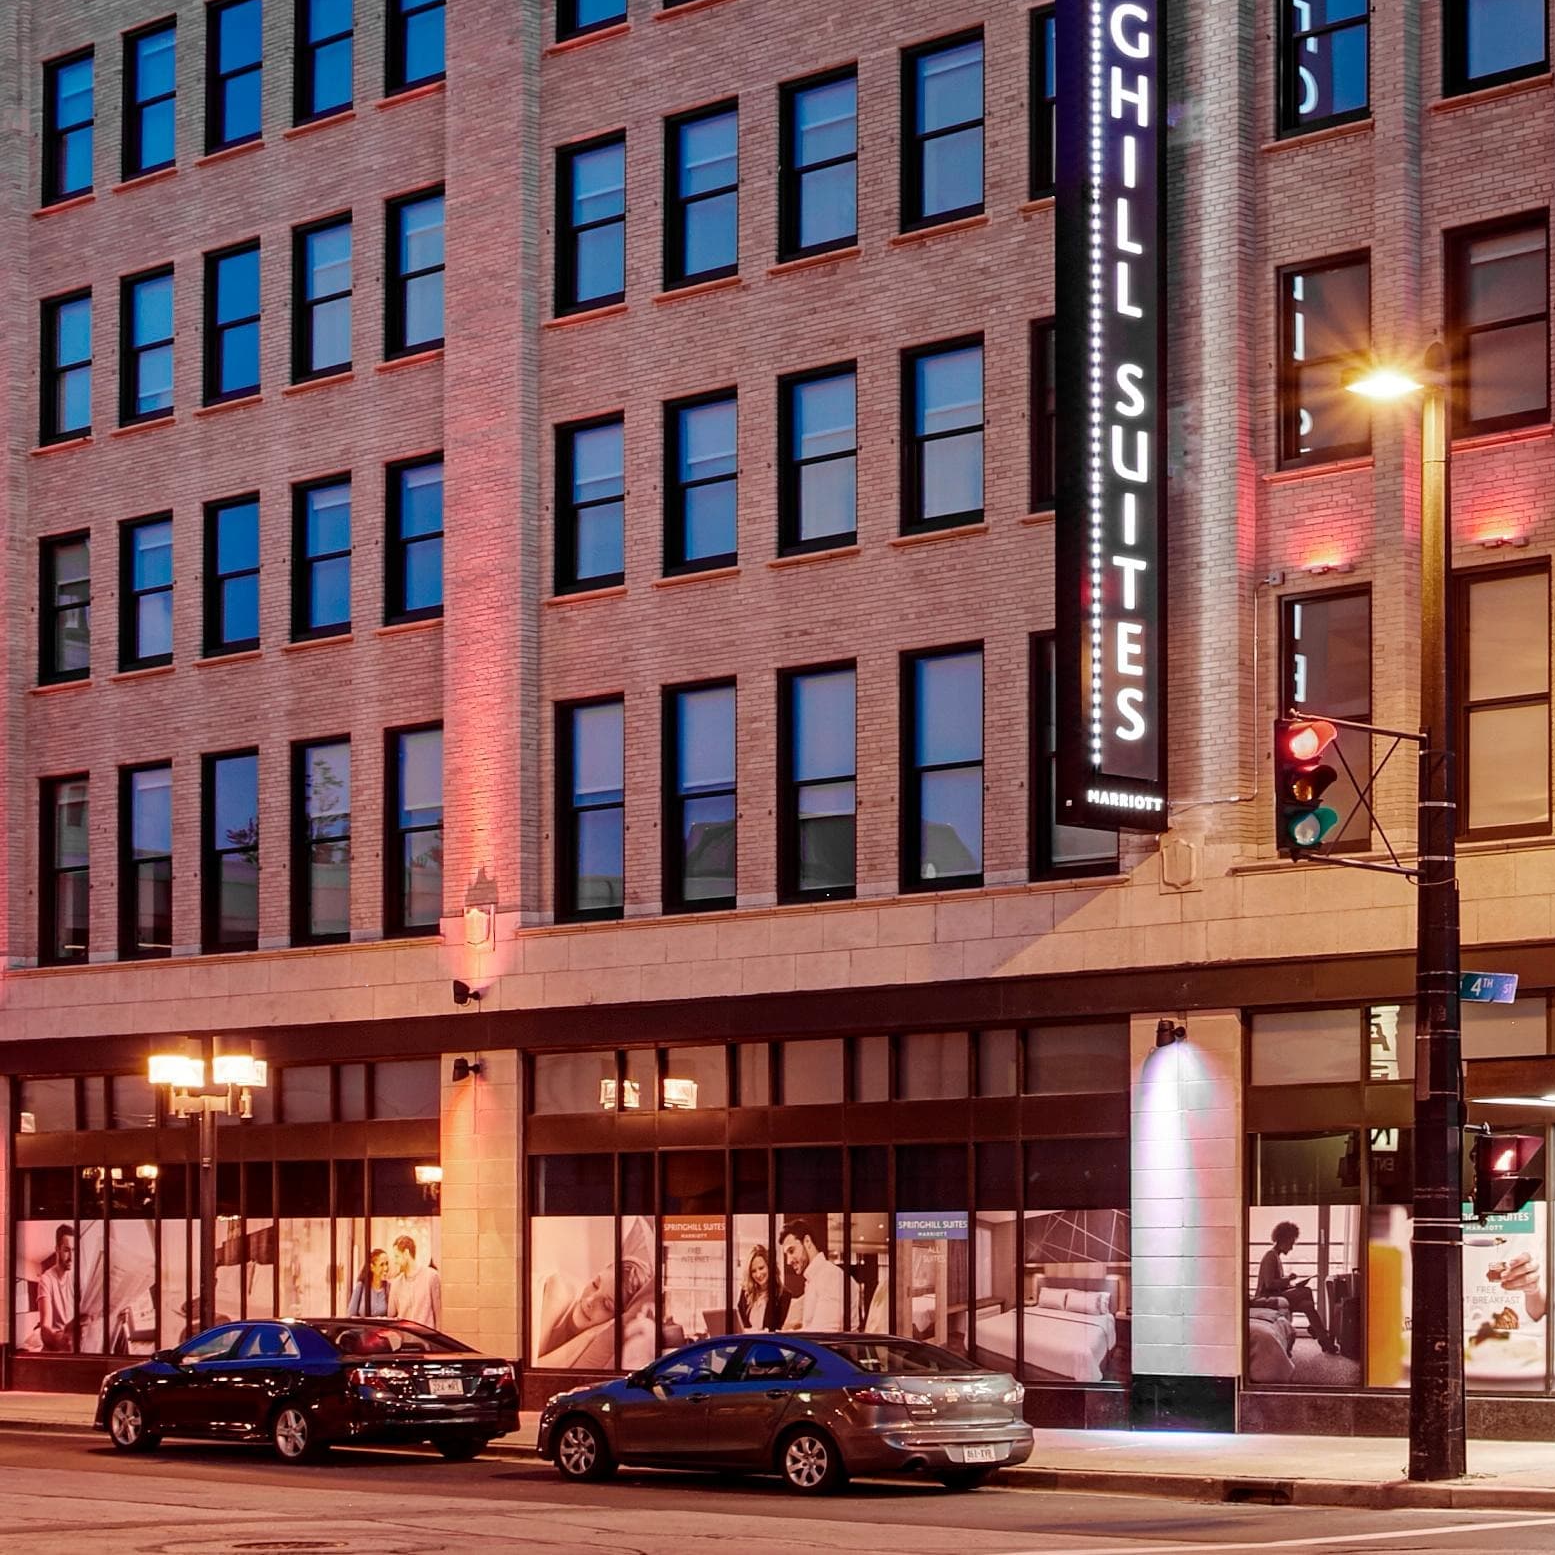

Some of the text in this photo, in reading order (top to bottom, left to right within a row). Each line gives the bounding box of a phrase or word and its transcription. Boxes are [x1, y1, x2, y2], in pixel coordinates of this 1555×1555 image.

[1110, 362, 1149, 742] SUITES
[1087, 789, 1164, 812] MARRIOTT
[1503, 983, 1513, 994] ST
[663, 1223, 725, 1231] SPRINGHILL SUITES
[898, 1220, 969, 1229] SPRINGHILL SUITES
[1472, 1296, 1521, 1304] BREAKFAST
